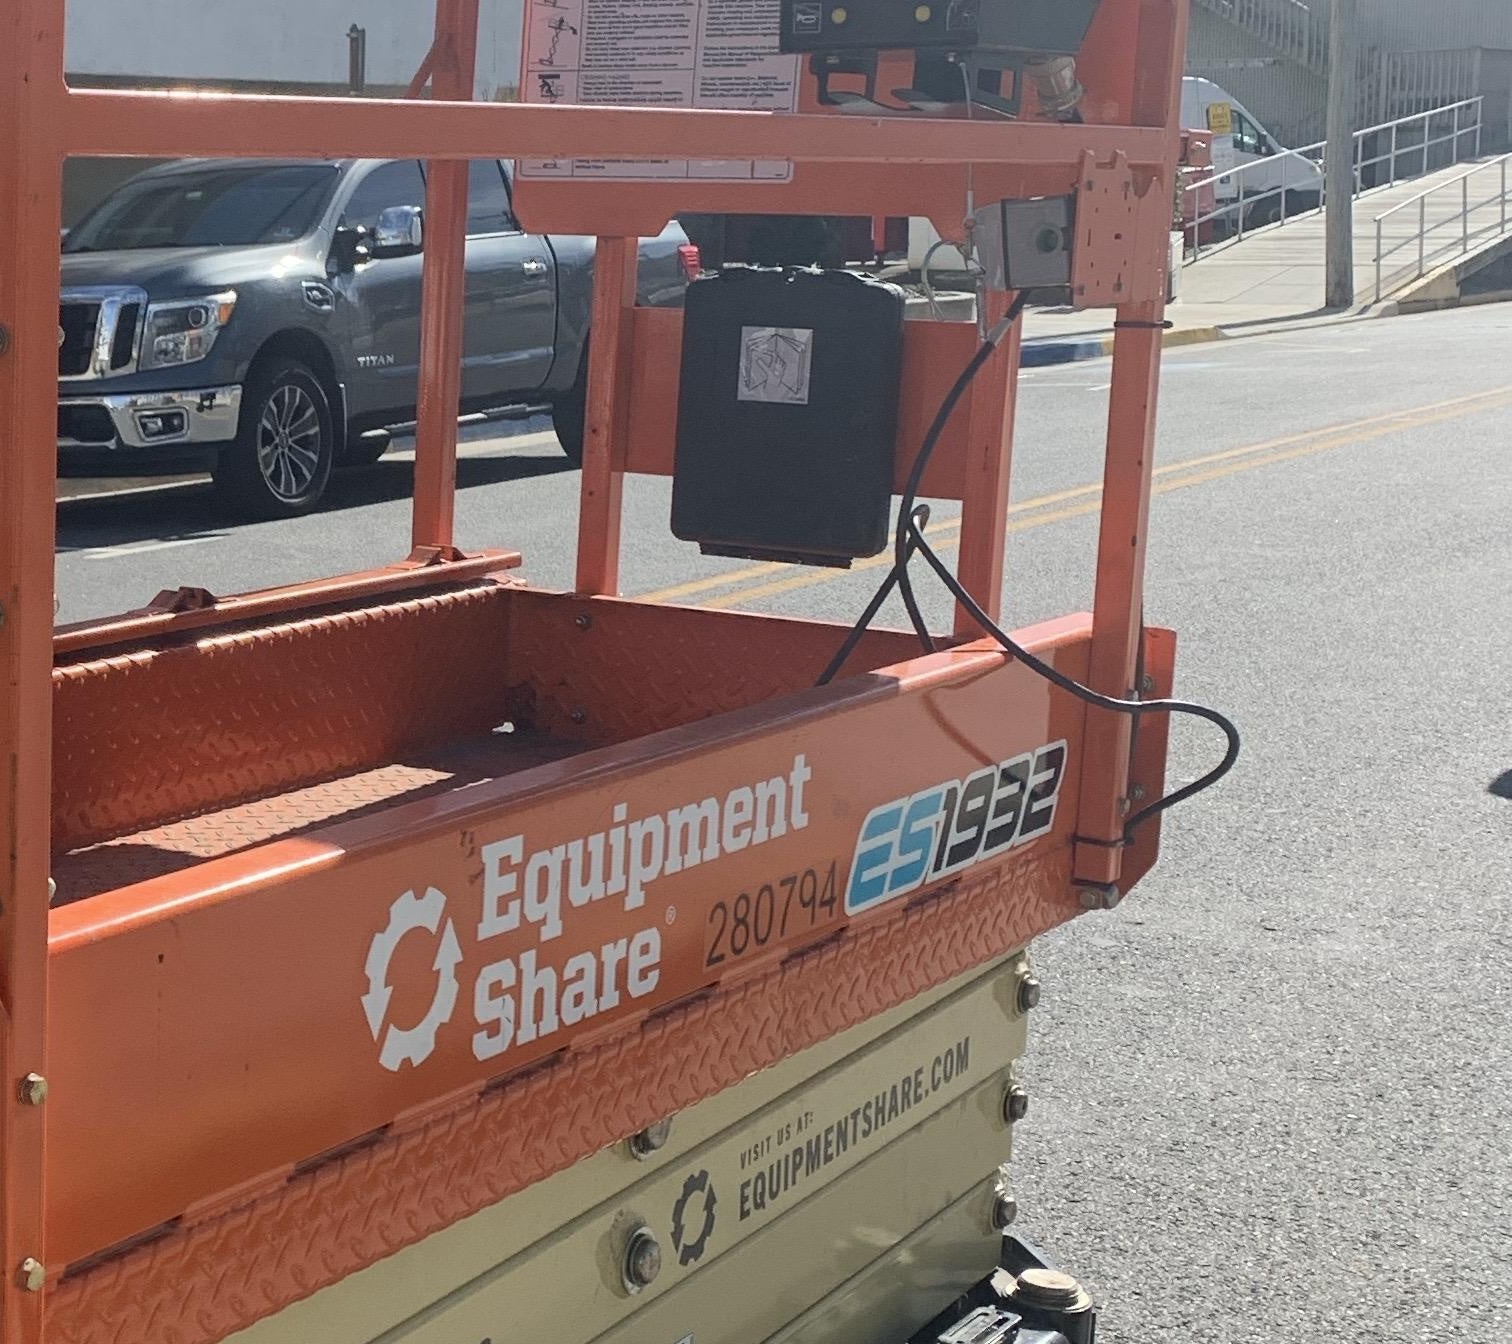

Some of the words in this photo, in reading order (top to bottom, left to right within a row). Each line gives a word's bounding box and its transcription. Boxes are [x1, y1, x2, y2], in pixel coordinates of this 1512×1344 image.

[357, 354, 394, 368] TITAN
[476, 753, 812, 942] Equipment
[844, 738, 1068, 916] ES1932
[705, 860, 838, 968] 280794
[471, 926, 662, 1062] Share
[739, 1035, 971, 1222] EQUIPMENTSHARE.COM
[740, 1134, 772, 1170] VISIT
[776, 1123, 791, 1146] US
[796, 1111, 814, 1134] AT:
